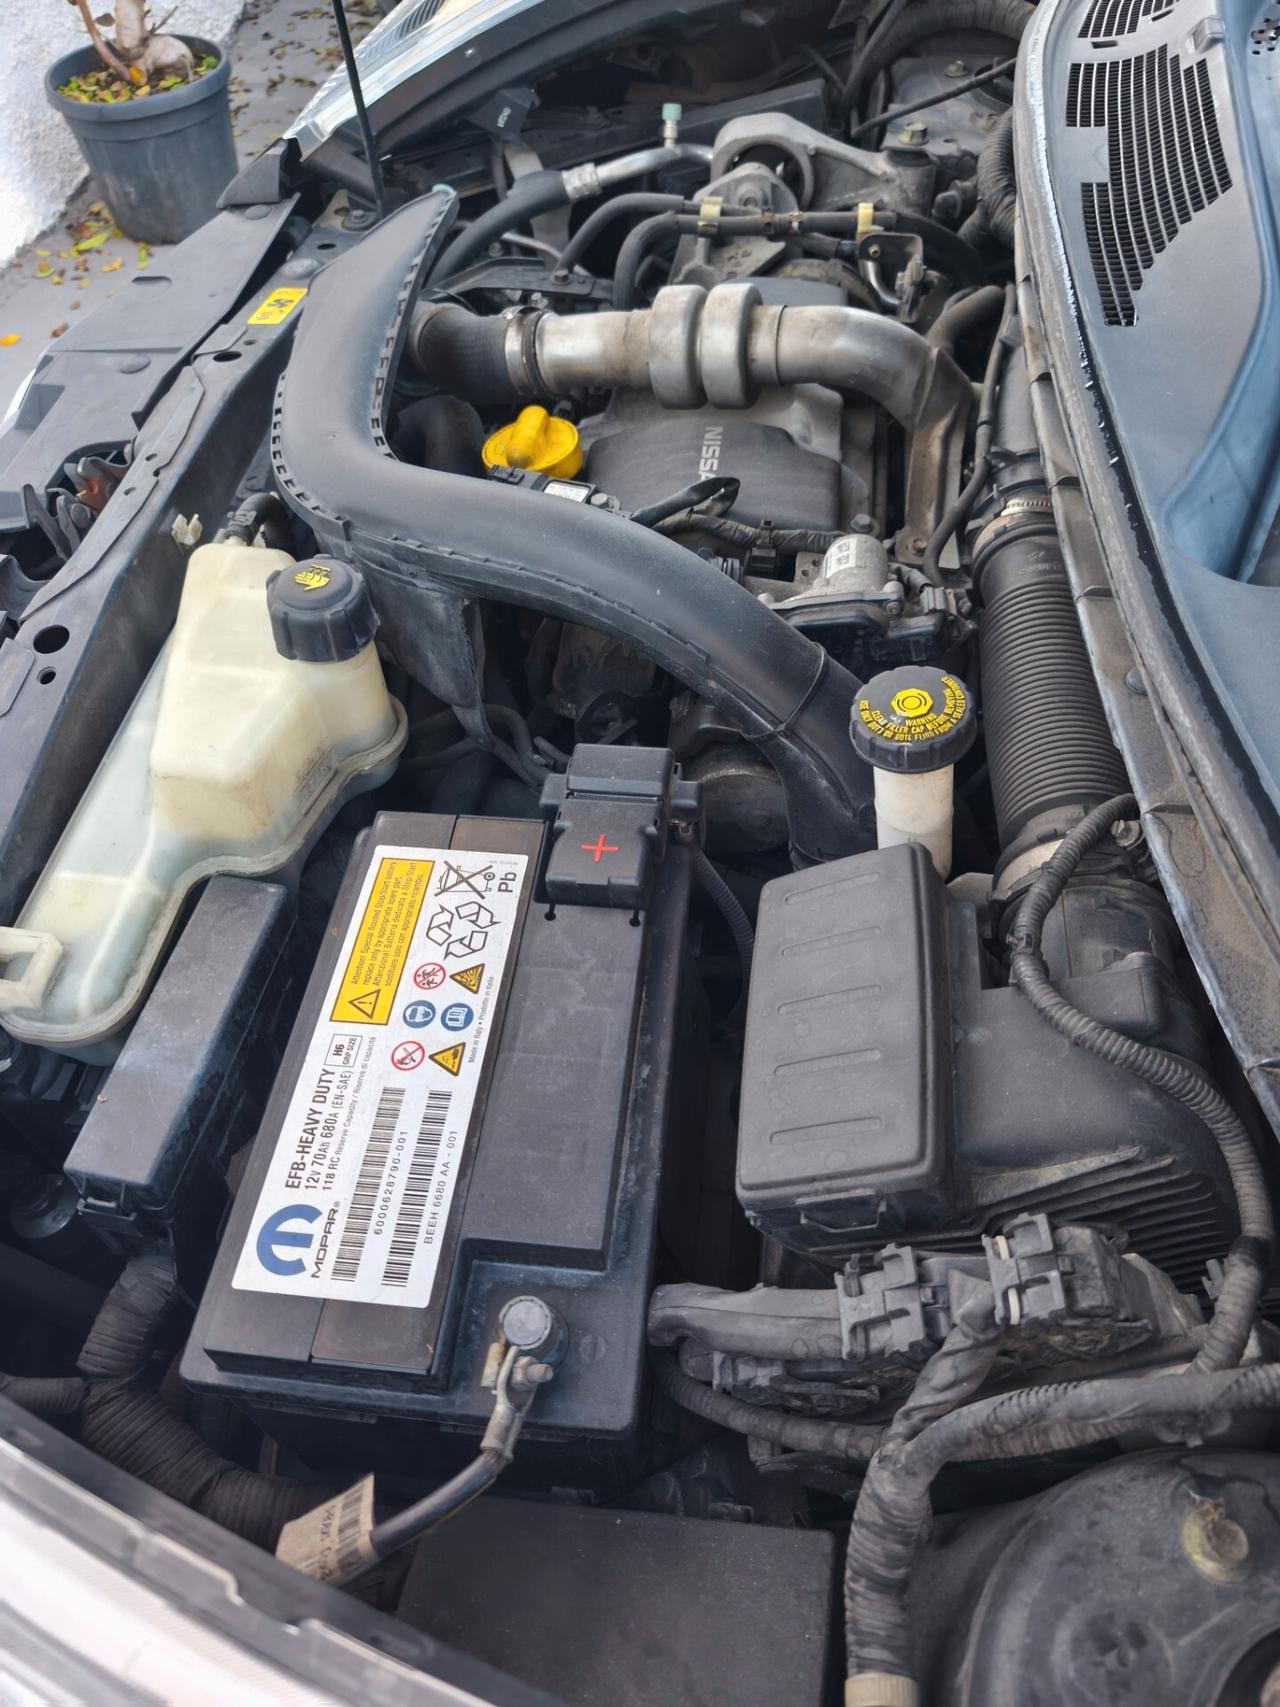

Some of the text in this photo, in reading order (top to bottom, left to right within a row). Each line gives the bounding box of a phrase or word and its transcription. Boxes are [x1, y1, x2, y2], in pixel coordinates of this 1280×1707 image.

[885, 722, 909, 734] FILLER
[911, 725, 925, 734] CAP
[926, 713, 951, 731] BEFORE
[905, 712, 938, 727] WARNING
[497, 871, 516, 892] Pb
[366, 909, 381, 931] flooded
[359, 931, 375, 953] Special
[372, 950, 390, 986] Attenzione!
[383, 924, 398, 948] Batteria
[391, 896, 407, 923] dedicata
[372, 939, 383, 947] by
[391, 944, 403, 957] solo
[397, 932, 406, 943] con
[368, 948, 380, 961] only
[361, 962, 376, 985] replace
[485, 976, 494, 989] Italia
[477, 997, 489, 1020] Prodotto
[473, 1026, 483, 1038] Italy
[332, 1043, 344, 1056] H6
[342, 1037, 356, 1064] GRP SIZE
[467, 1046, 477, 1062] Made
[352, 1070, 366, 1093] Riserva
[320, 1112, 338, 1138] 680A
[331, 1070, 353, 1108] (EN-SAE)
[342, 1099, 358, 1127] Capacity
[284, 1068, 335, 1188] EFB-HEAVY DUTY
[334, 1128, 348, 1154] Reserve
[327, 1156, 340, 1169] RC
[322, 1172, 335, 1190] 118
[373, 1131, 407, 1235] 6000628790-001
[423, 1211, 438, 1244] BEEH
[432, 1180, 446, 1207] 6680
[440, 1161, 450, 1176] AA
[445, 1131, 457, 1148] 001
